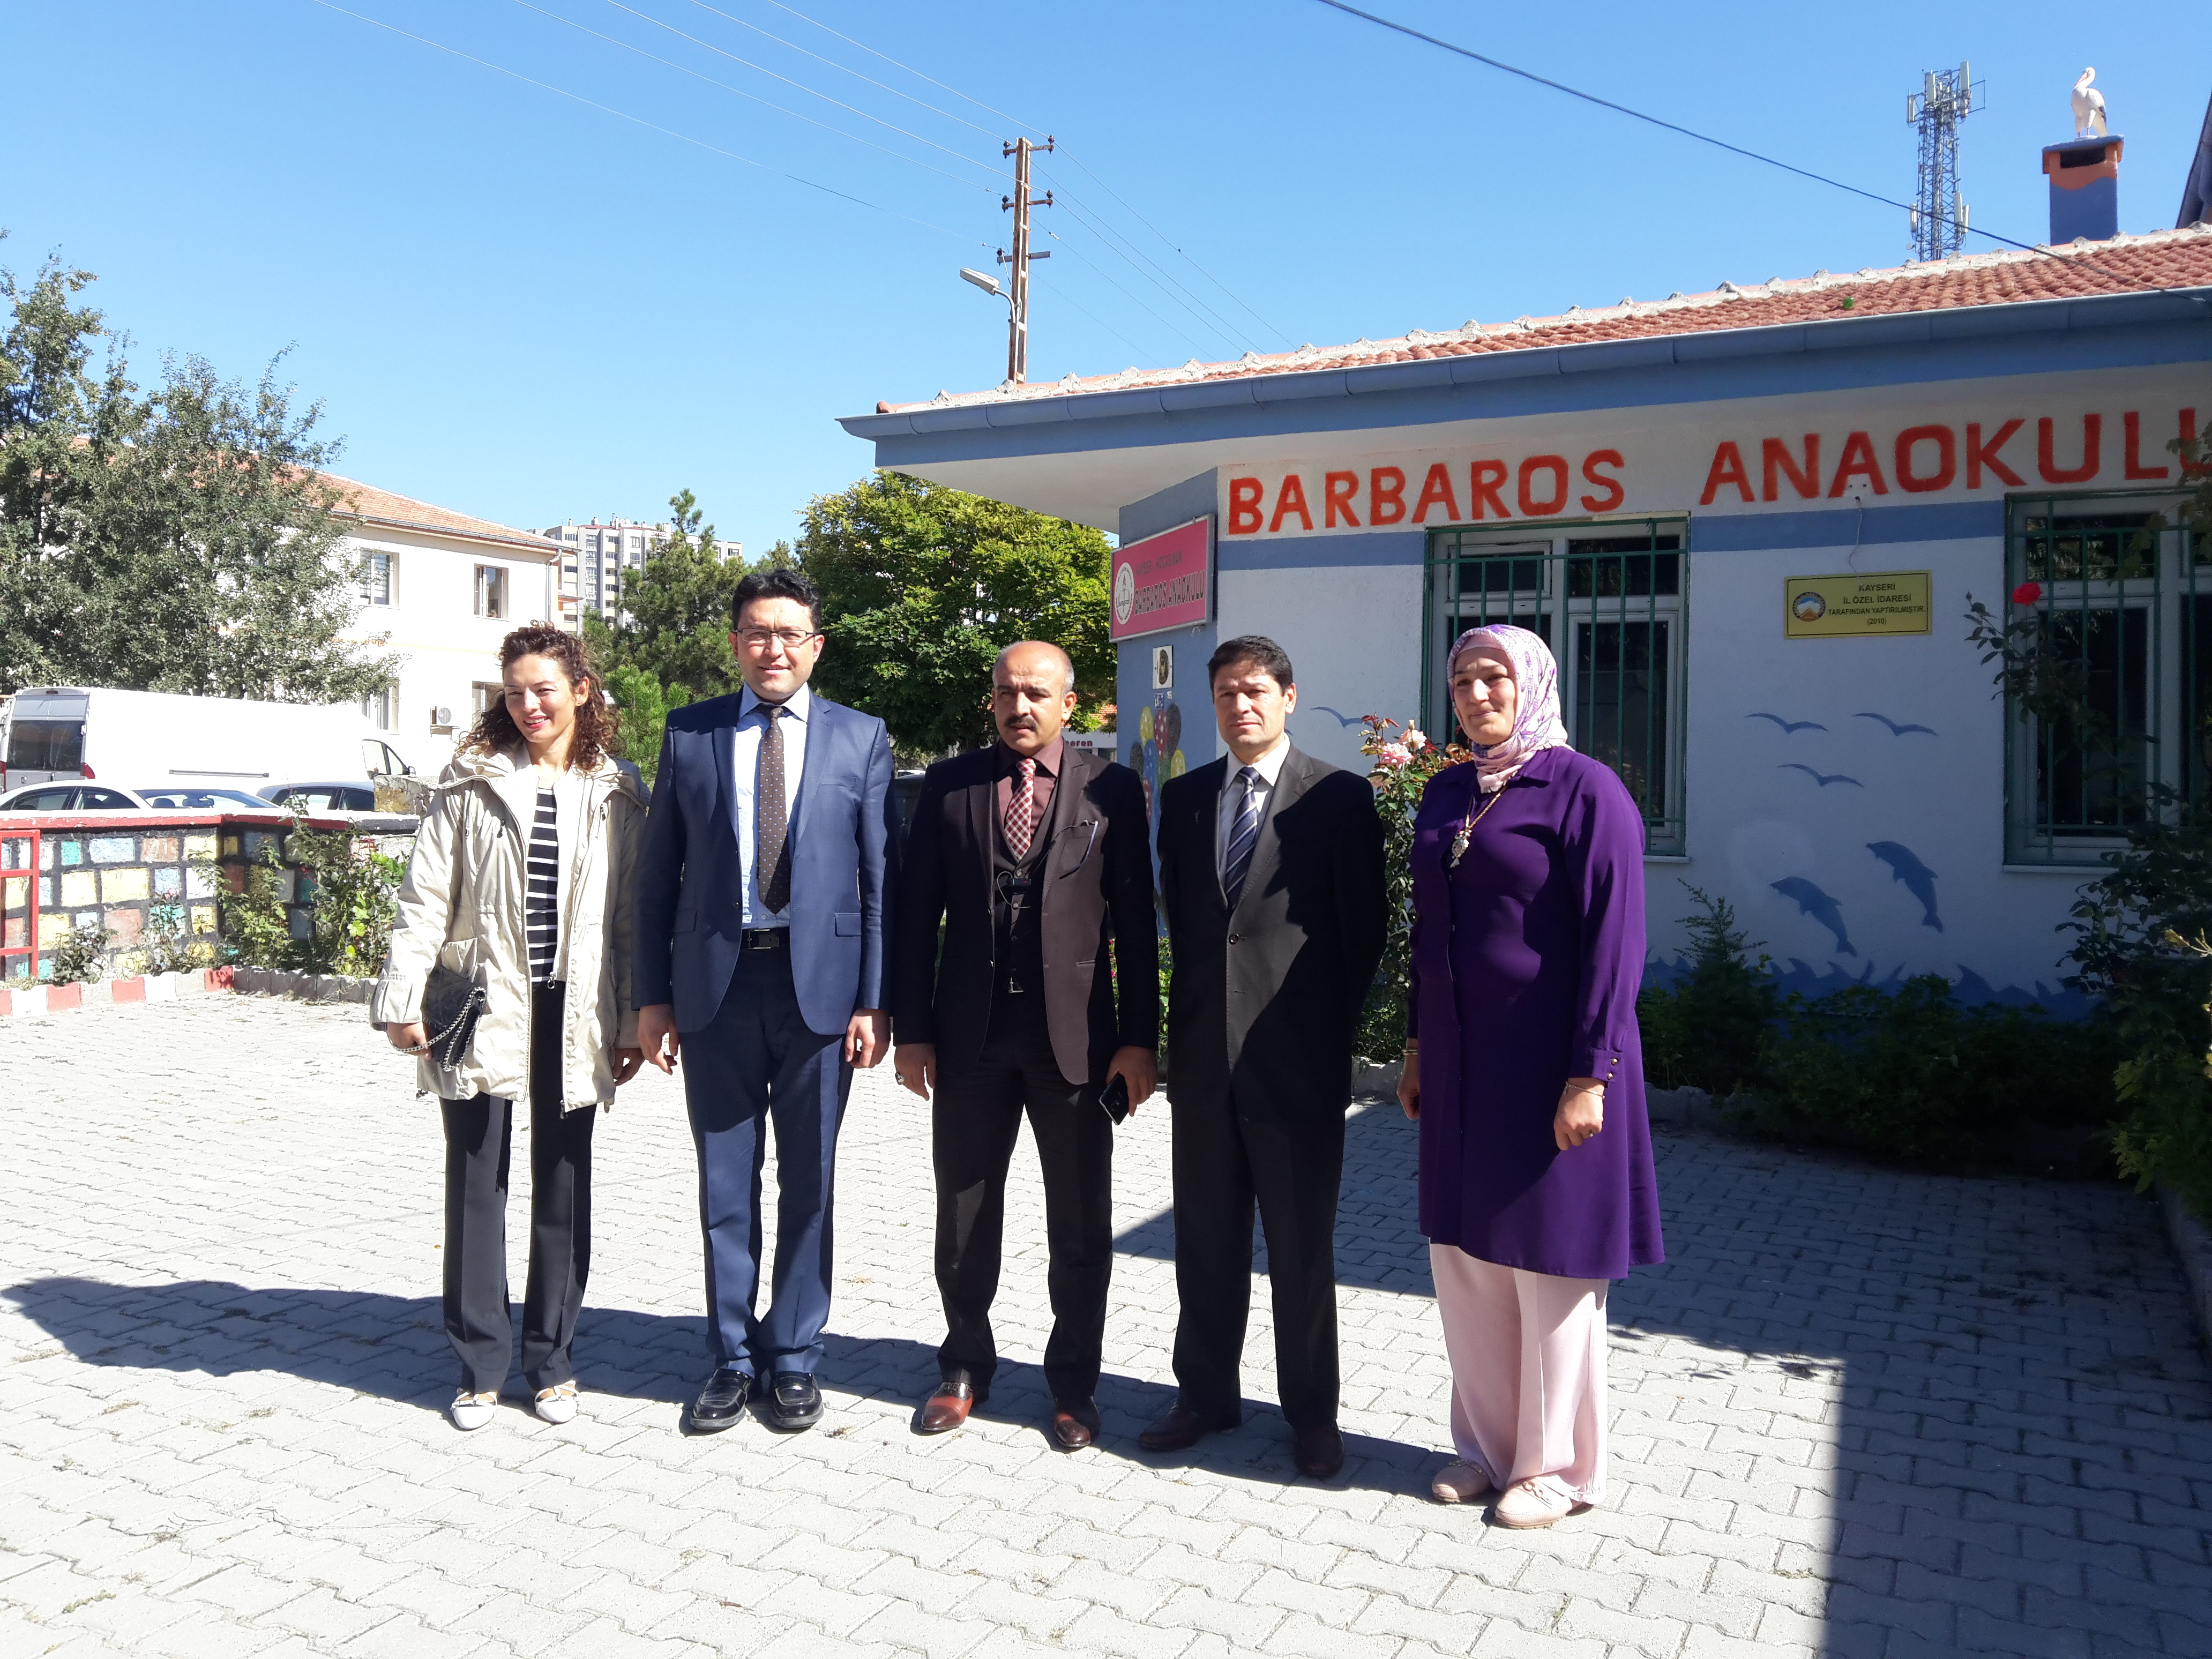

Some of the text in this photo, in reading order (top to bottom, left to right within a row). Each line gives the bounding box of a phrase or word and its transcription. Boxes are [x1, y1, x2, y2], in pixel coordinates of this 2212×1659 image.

[1228, 449, 1625, 535] BARBAROS
[1859, 582, 1895, 592] KAYSERİ
[1134, 580, 1167, 615] BARBAROS
[1168, 570, 1205, 607] ANAOKULU
[1843, 593, 1911, 604] İL ÖZEL İDARESİ
[1828, 607, 1870, 616] TARAFINDAN
[1867, 617, 1887, 626] (2010)
